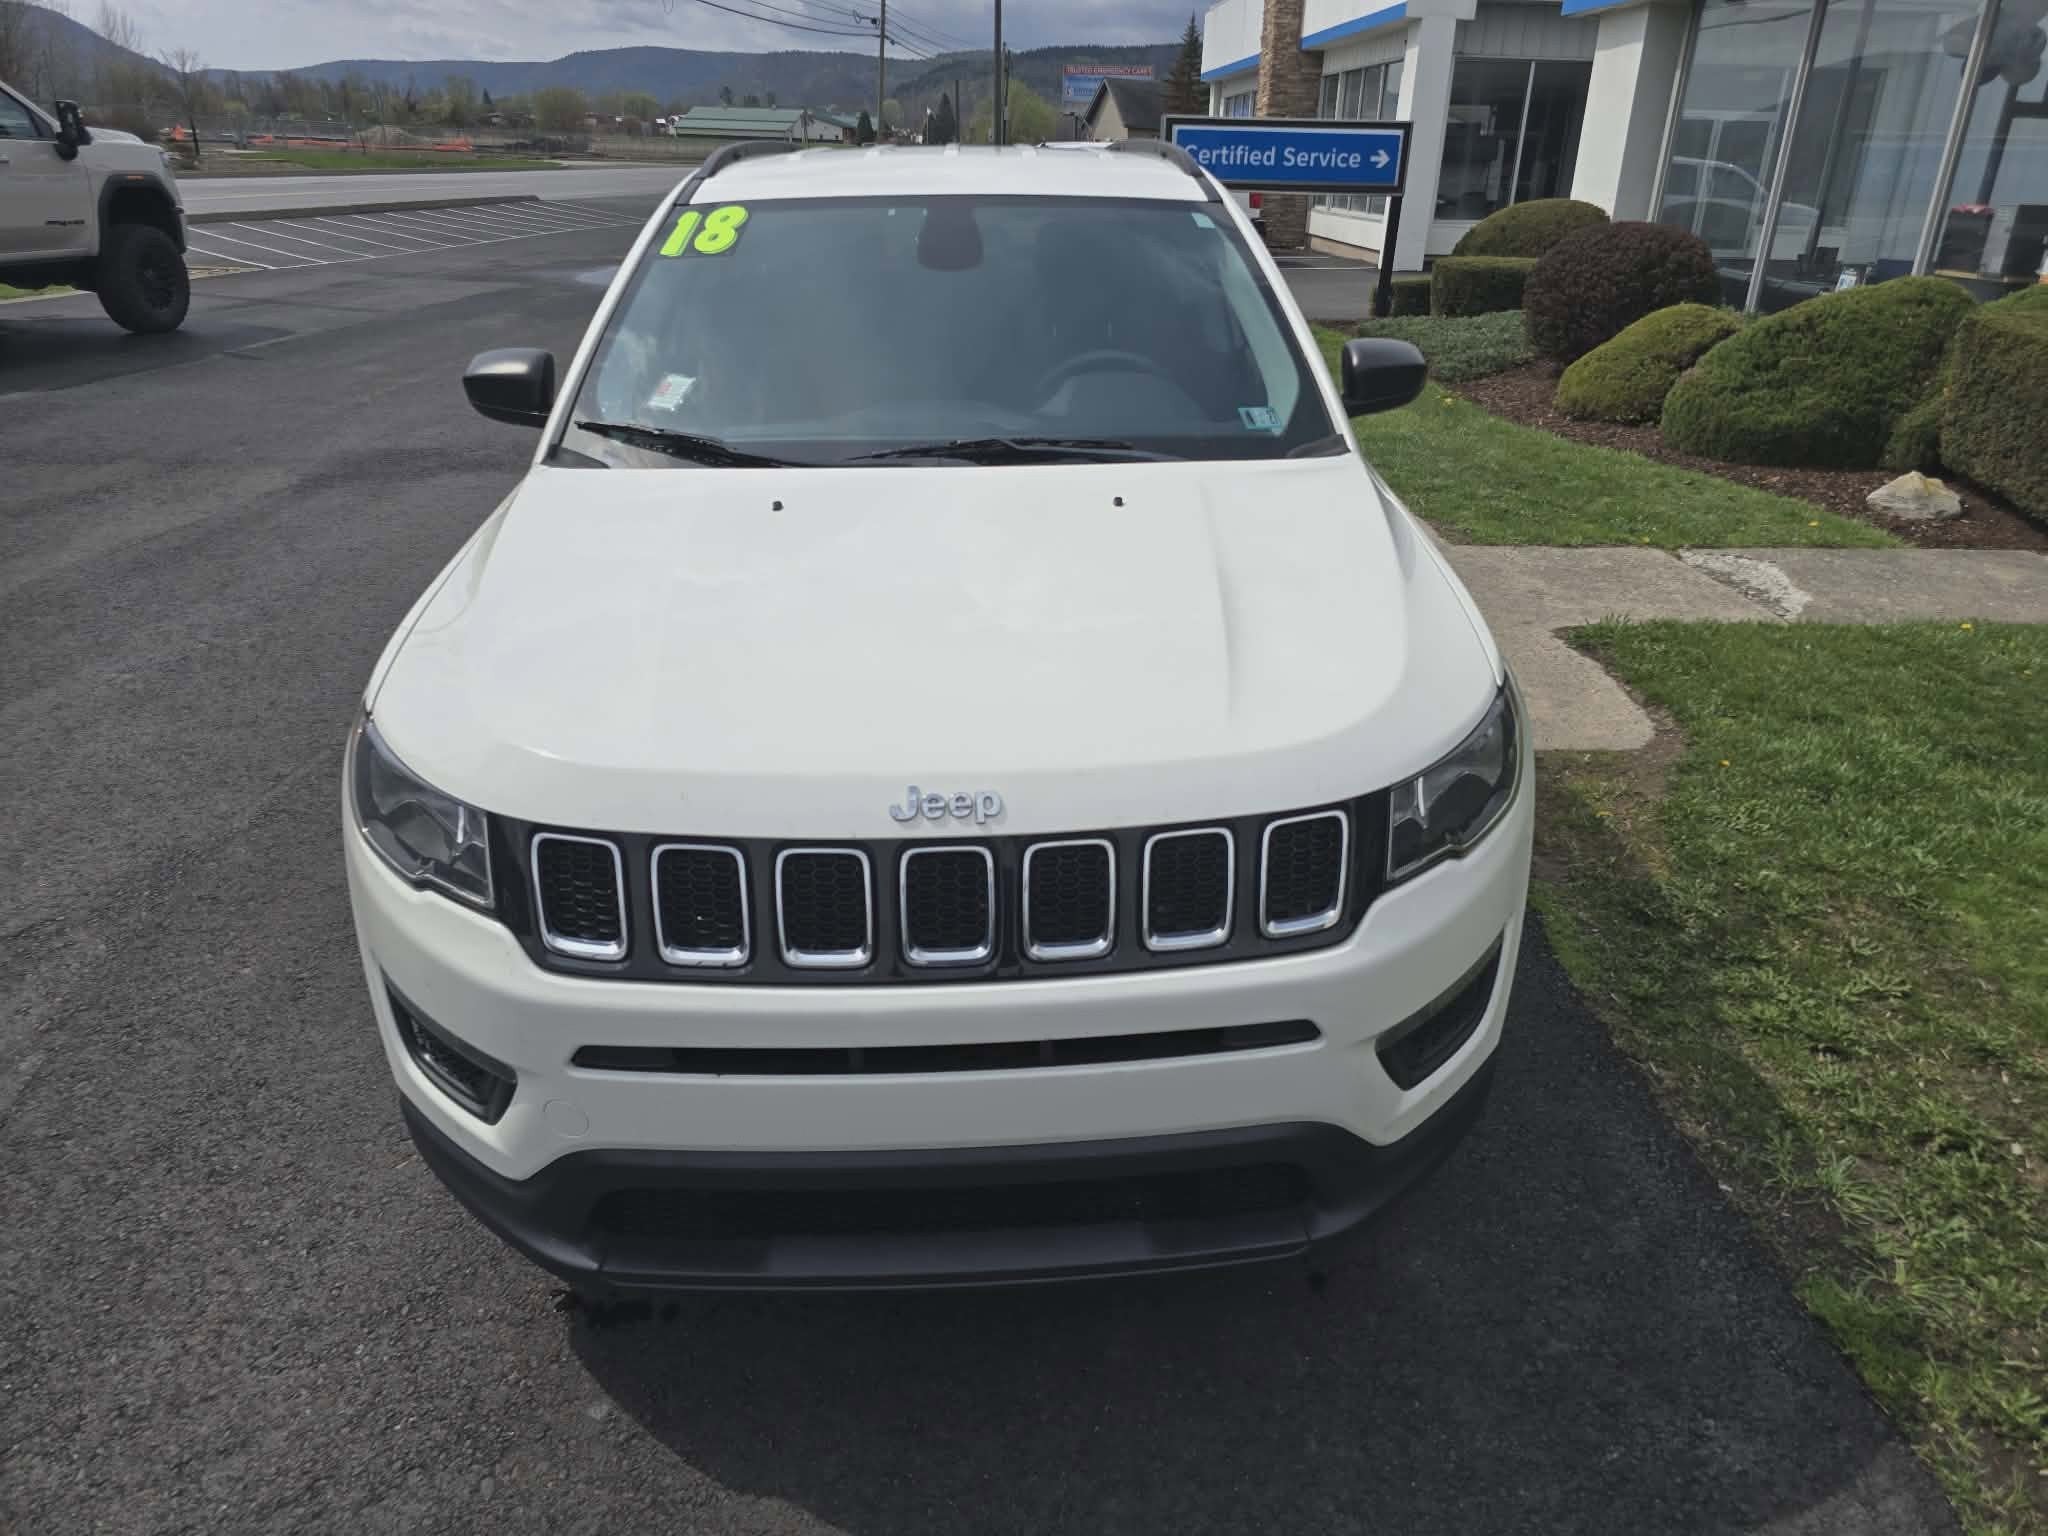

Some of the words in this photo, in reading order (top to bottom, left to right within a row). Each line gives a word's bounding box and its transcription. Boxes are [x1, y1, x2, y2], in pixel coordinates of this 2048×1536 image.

[1282, 146, 1361, 168] Service
[659, 205, 749, 257] 18
[889, 785, 1004, 824] Jeep
